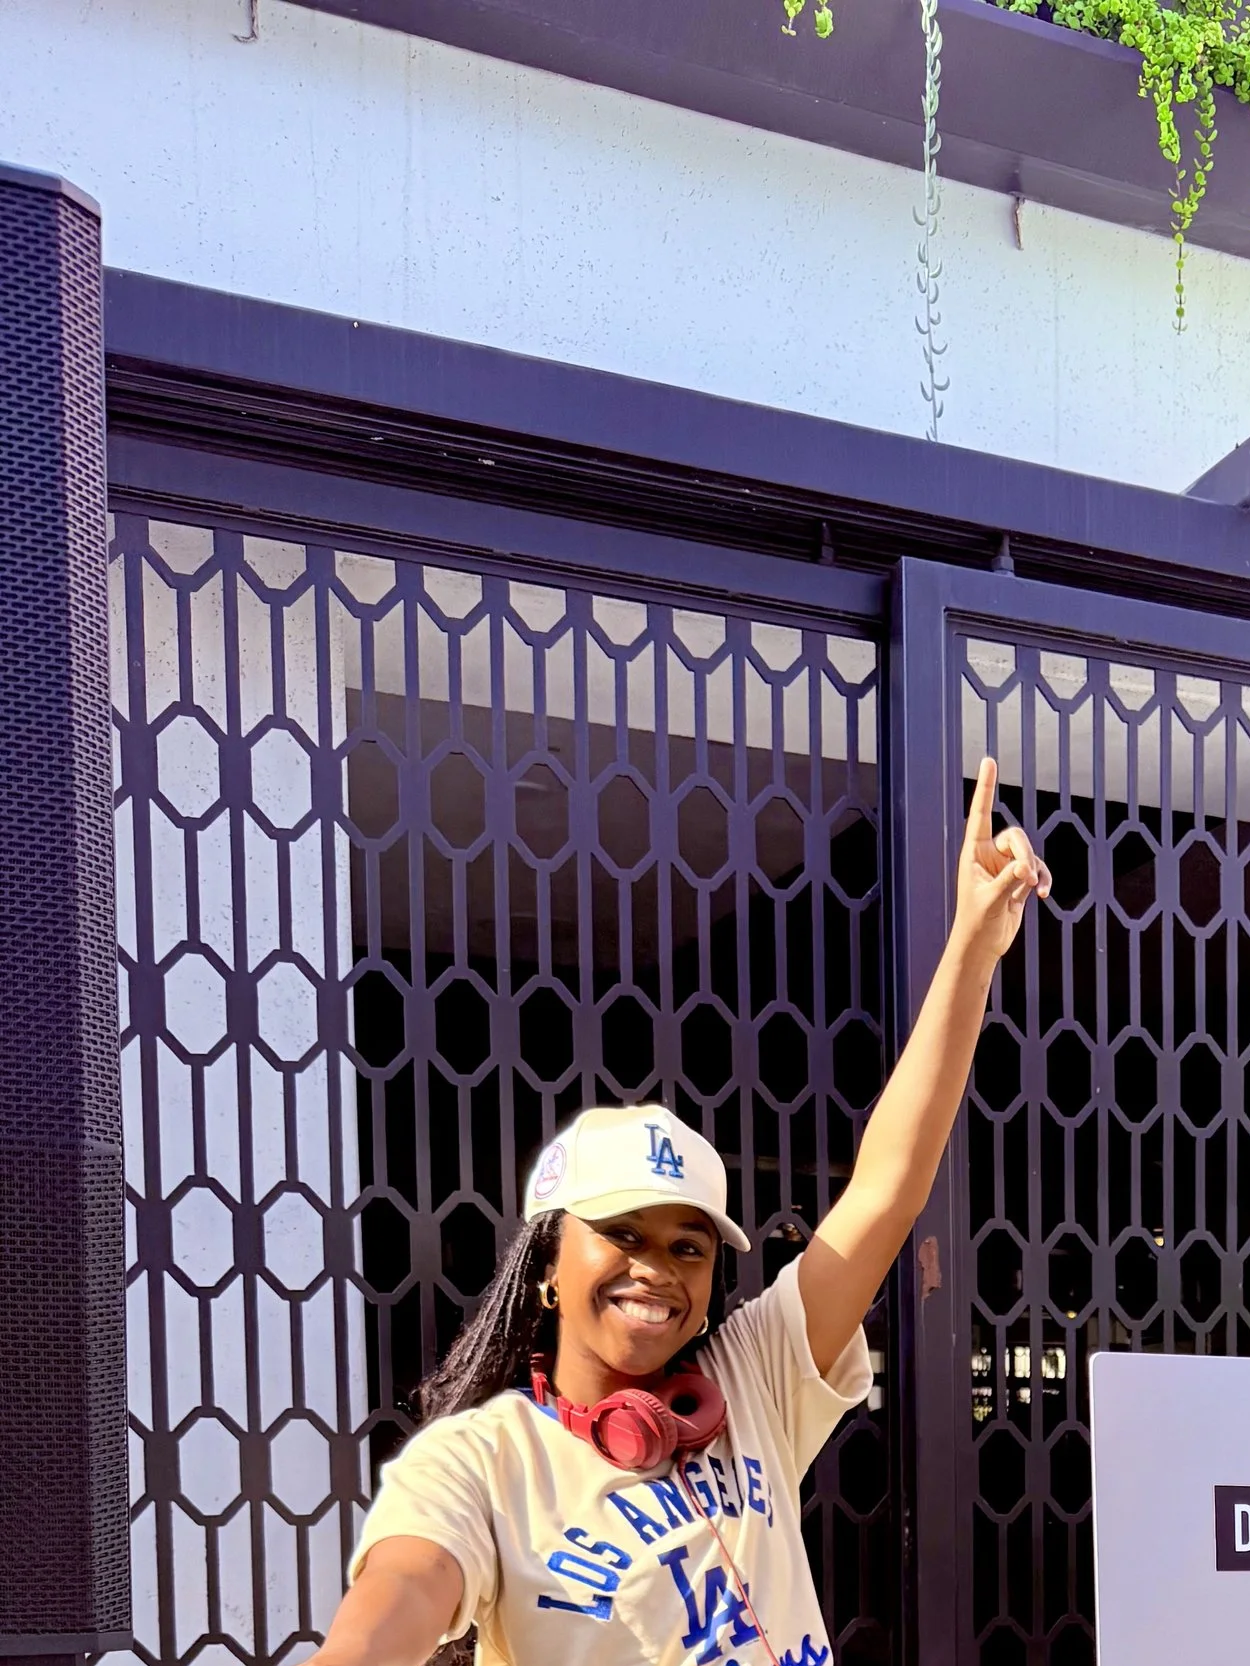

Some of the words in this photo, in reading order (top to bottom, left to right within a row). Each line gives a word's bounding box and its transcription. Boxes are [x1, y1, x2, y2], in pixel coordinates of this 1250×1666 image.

[644, 1124, 684, 1179] LA
[537, 1527, 633, 1621] LOS
[606, 1453, 774, 1545] ANGEE
[657, 1545, 762, 1666] LA
